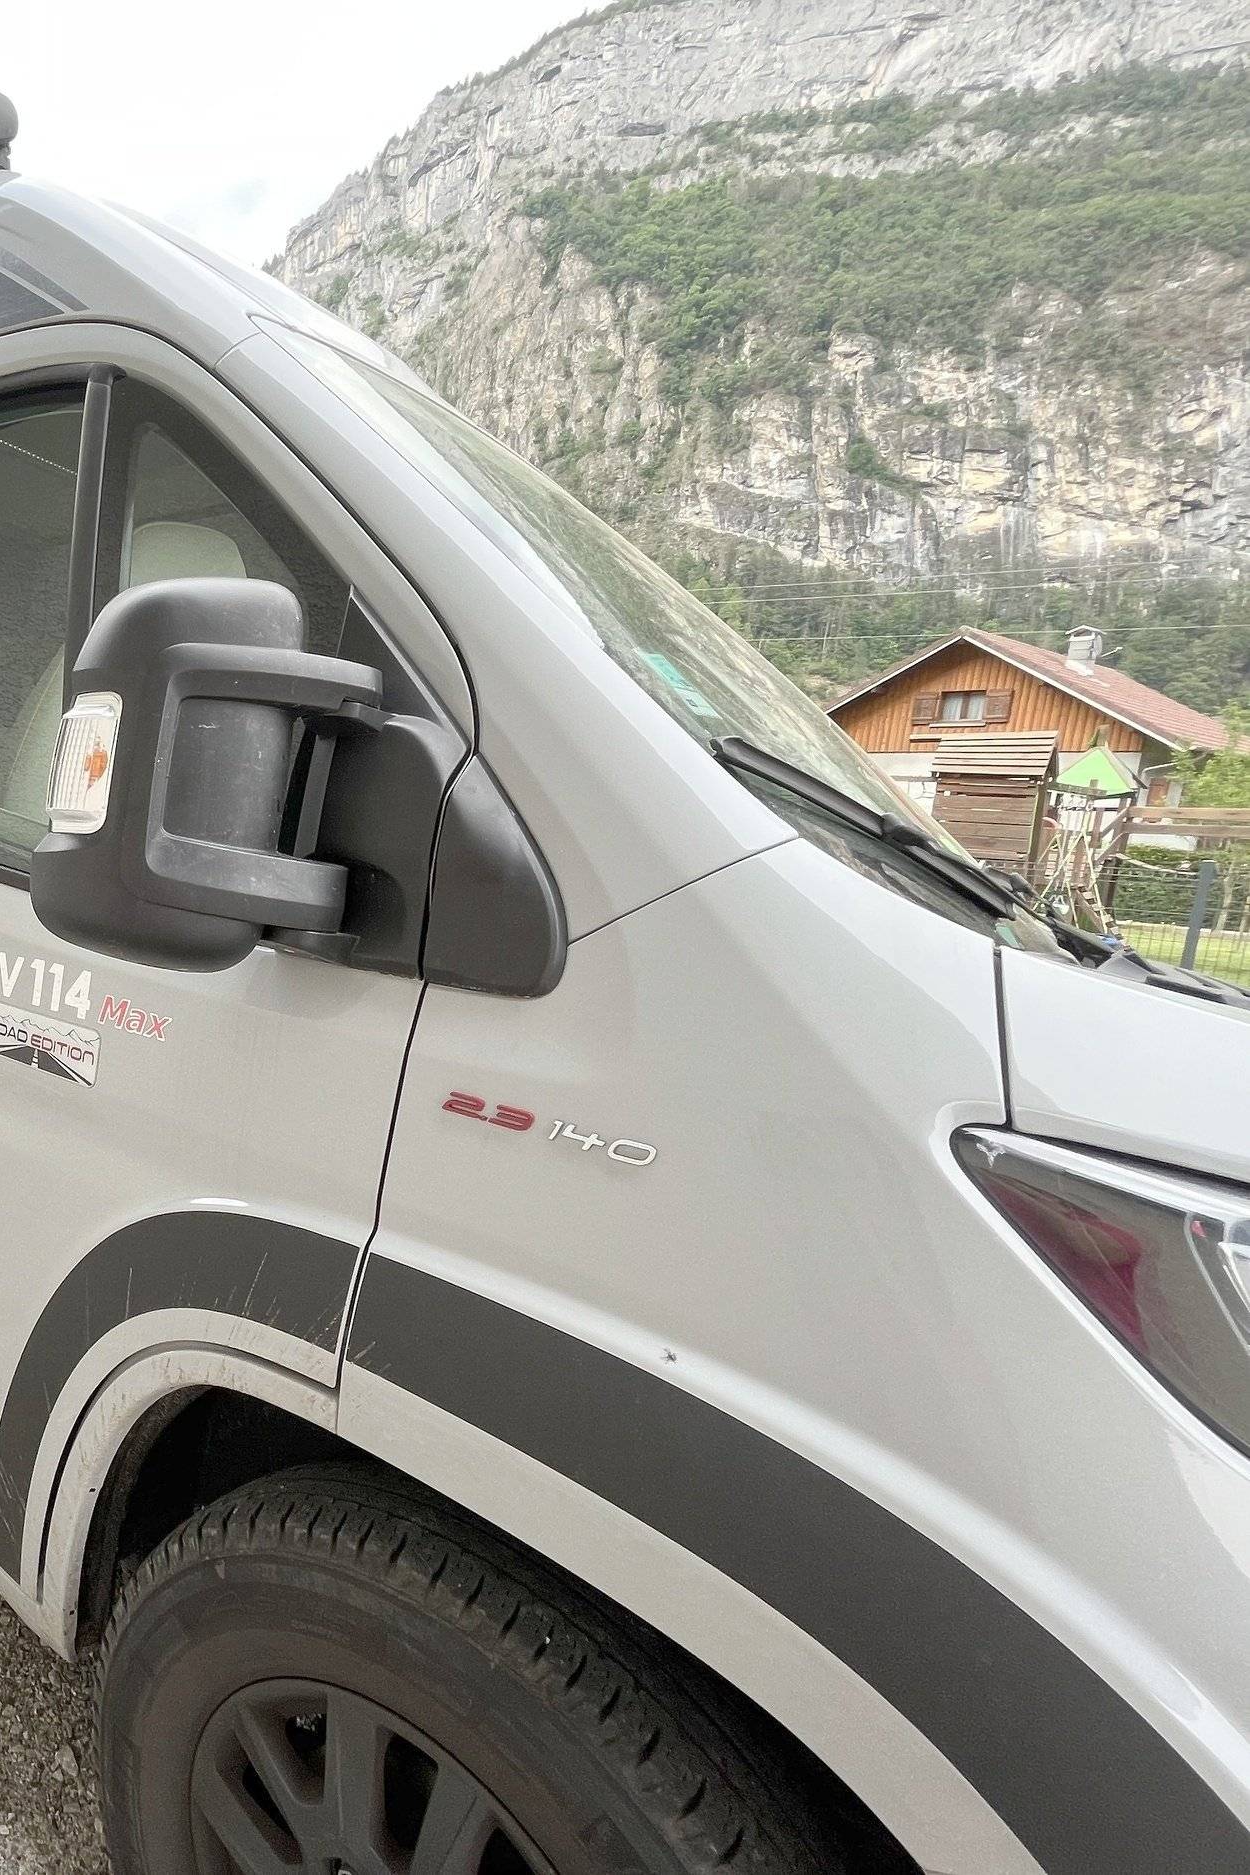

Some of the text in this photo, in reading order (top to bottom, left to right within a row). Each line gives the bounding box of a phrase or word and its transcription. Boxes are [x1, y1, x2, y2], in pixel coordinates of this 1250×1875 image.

[98, 994, 173, 1042] Max
[441, 1091, 658, 1166] 2.3 140
